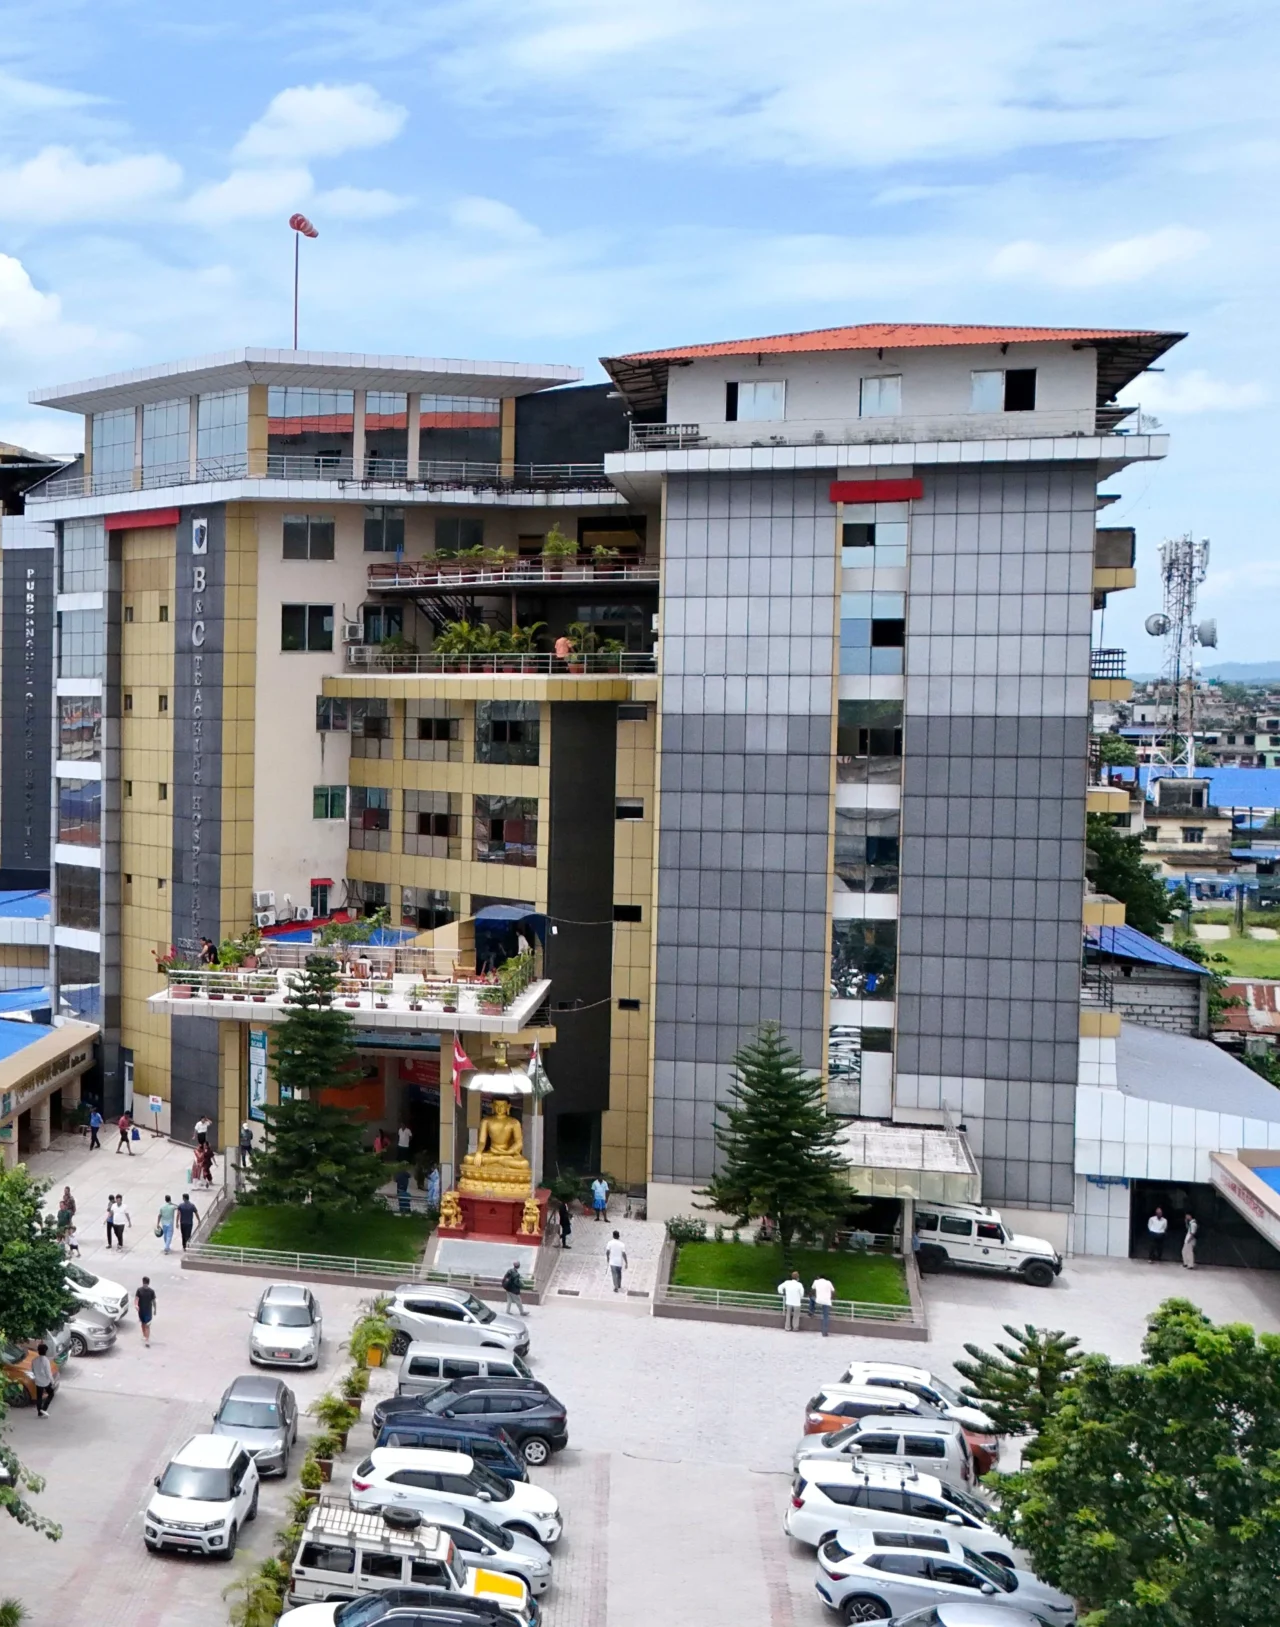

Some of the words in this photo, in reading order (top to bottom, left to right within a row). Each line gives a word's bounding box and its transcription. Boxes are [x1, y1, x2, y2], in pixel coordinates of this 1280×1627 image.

[192, 566, 206, 593] B
[195, 599, 203, 614] &
[192, 620, 205, 647] C
[193, 655, 202, 786] TEACHING
